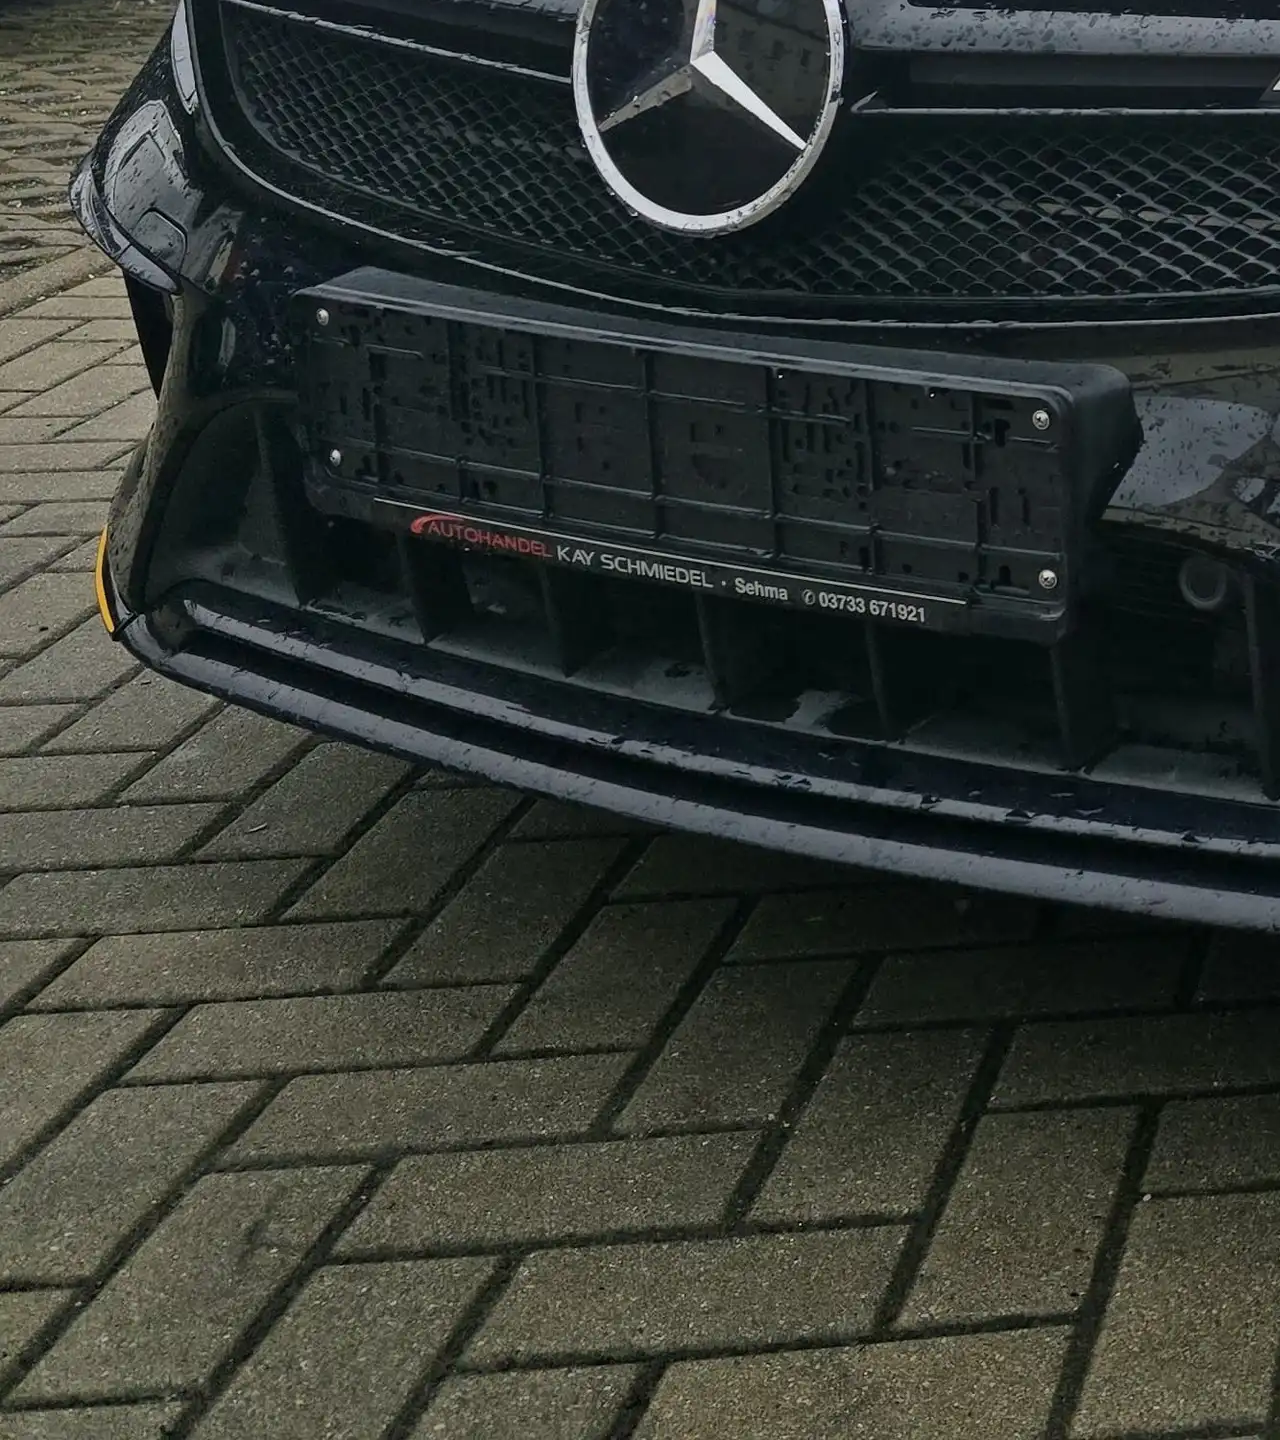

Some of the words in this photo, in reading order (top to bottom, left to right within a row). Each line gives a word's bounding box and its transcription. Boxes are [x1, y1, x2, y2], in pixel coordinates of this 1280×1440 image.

[427, 521, 552, 558] AUTOHANDEL
[556, 545, 596, 566] KAY
[600, 554, 714, 588] SCHMIEDEL
[734, 577, 788, 601] Sehma
[818, 591, 866, 613] 03733
[869, 599, 926, 623] 671921
